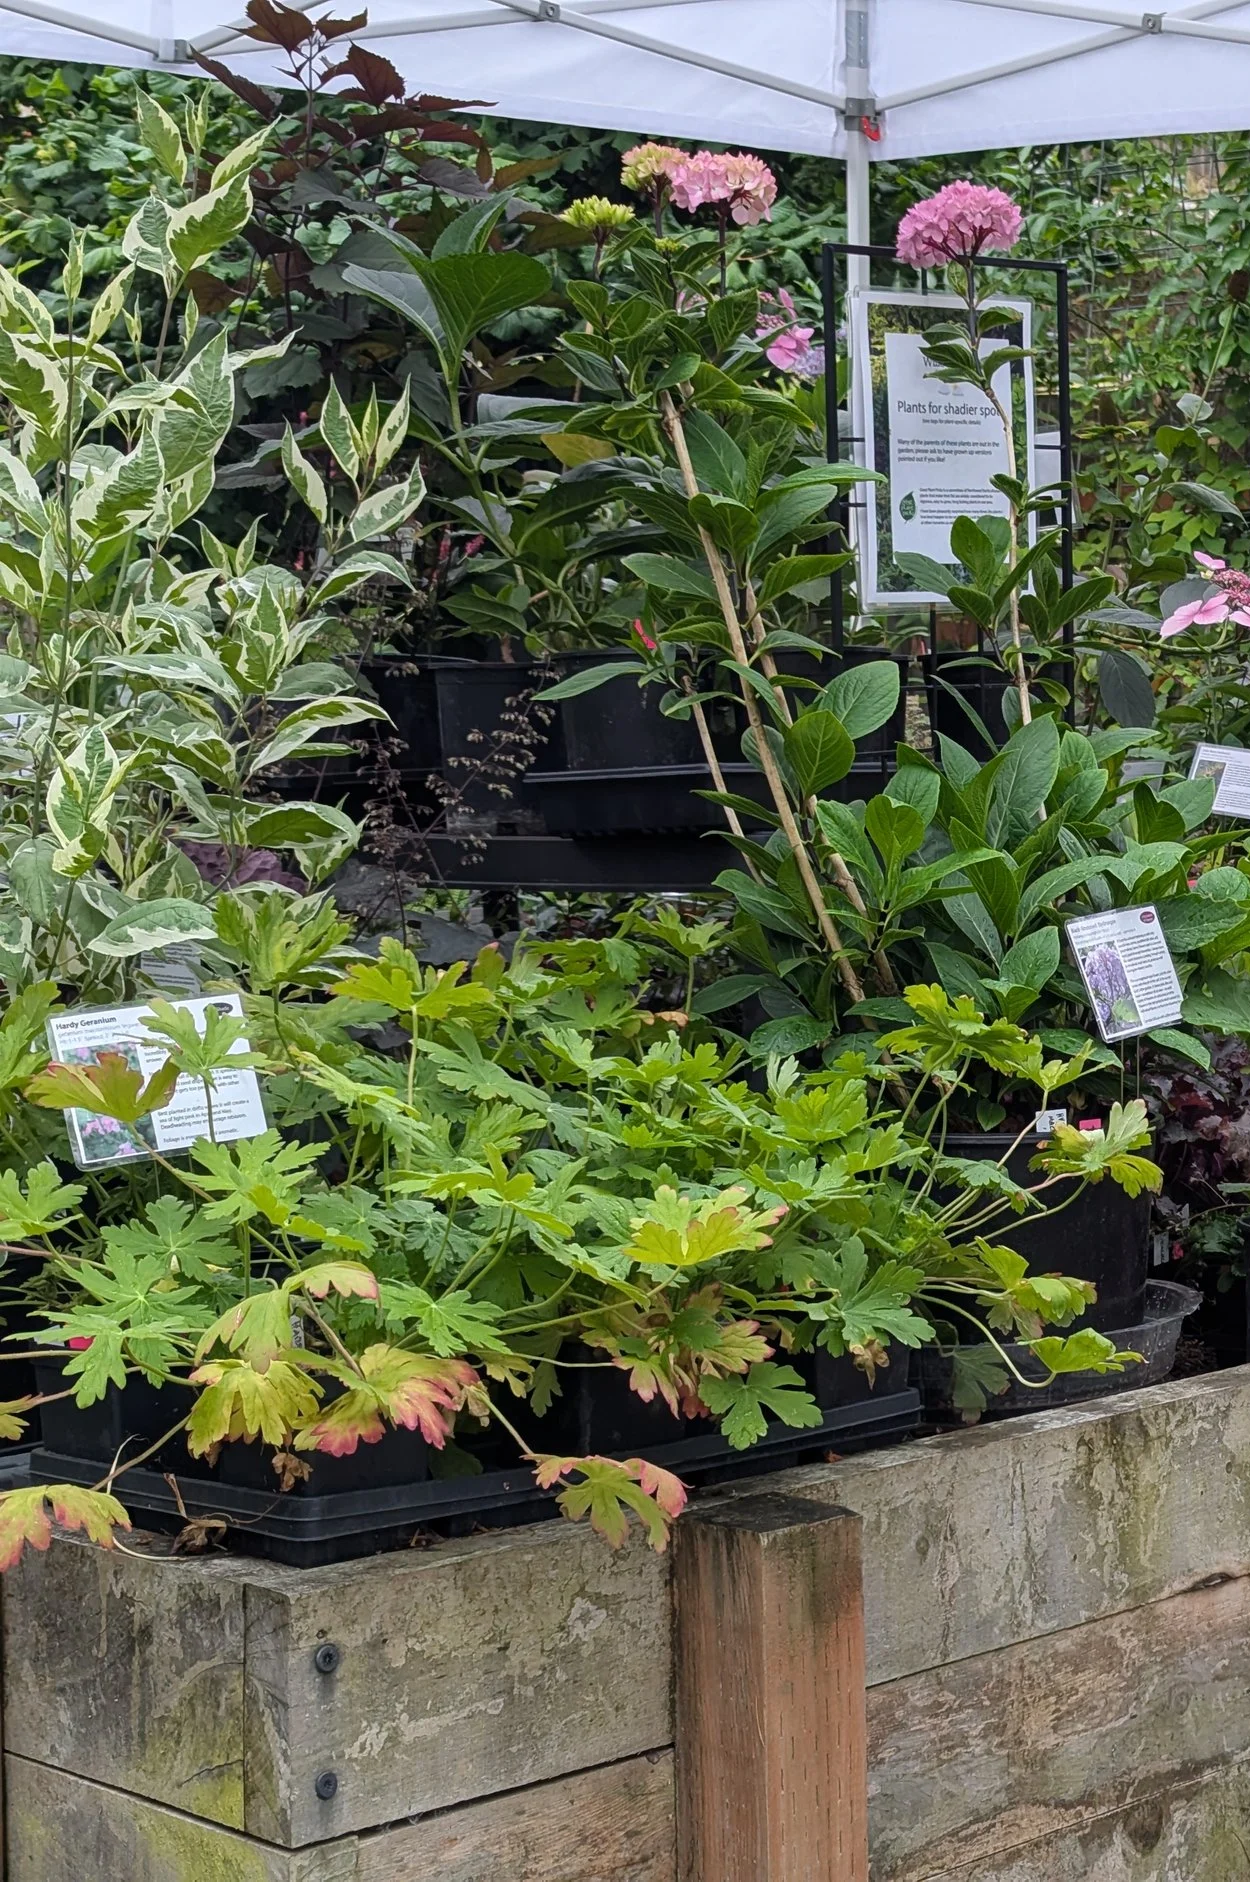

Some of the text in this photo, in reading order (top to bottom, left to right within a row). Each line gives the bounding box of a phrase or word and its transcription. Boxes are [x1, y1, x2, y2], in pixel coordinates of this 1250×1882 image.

[898, 401, 1000, 418] Plants for shadier spot
[56, 1021, 78, 1030] Hardy
[80, 1016, 117, 1027] Geranium
